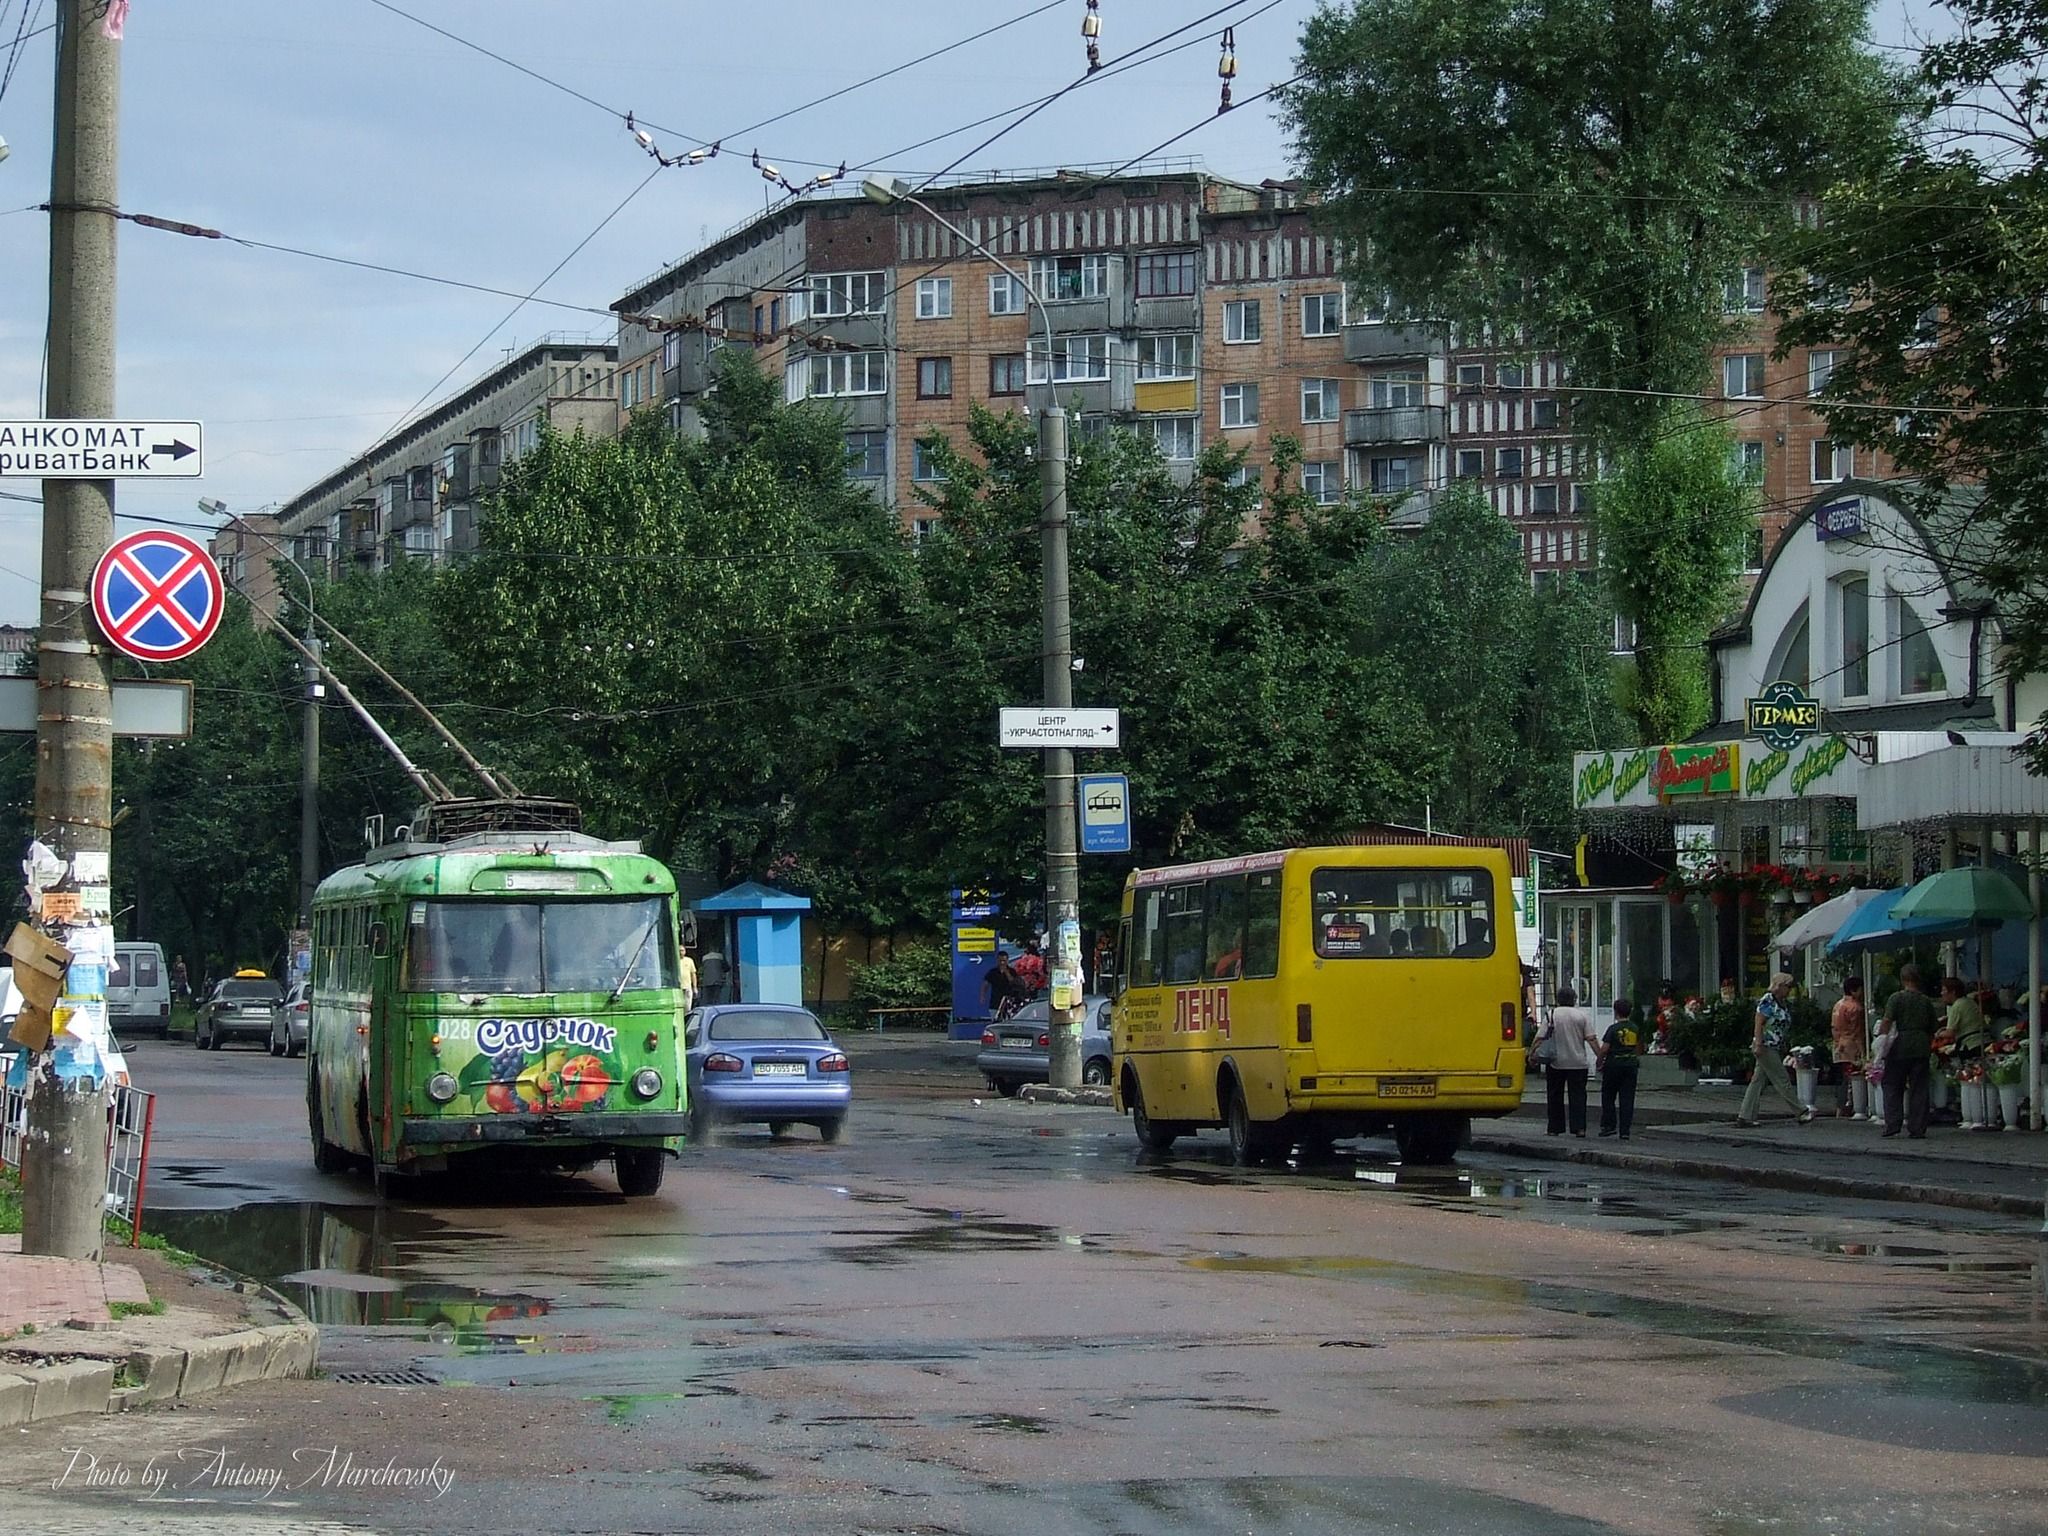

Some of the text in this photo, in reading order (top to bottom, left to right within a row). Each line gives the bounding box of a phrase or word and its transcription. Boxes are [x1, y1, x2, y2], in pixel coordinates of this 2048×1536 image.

[1038, 716, 1067, 726] ЦЕНТР
[506, 876, 514, 888] 5
[1455, 880, 1472, 895] 14
[1173, 987, 1231, 1040] ЛЕНД
[439, 1020, 470, 1040] 028
[476, 1018, 617, 1054] Садочок
